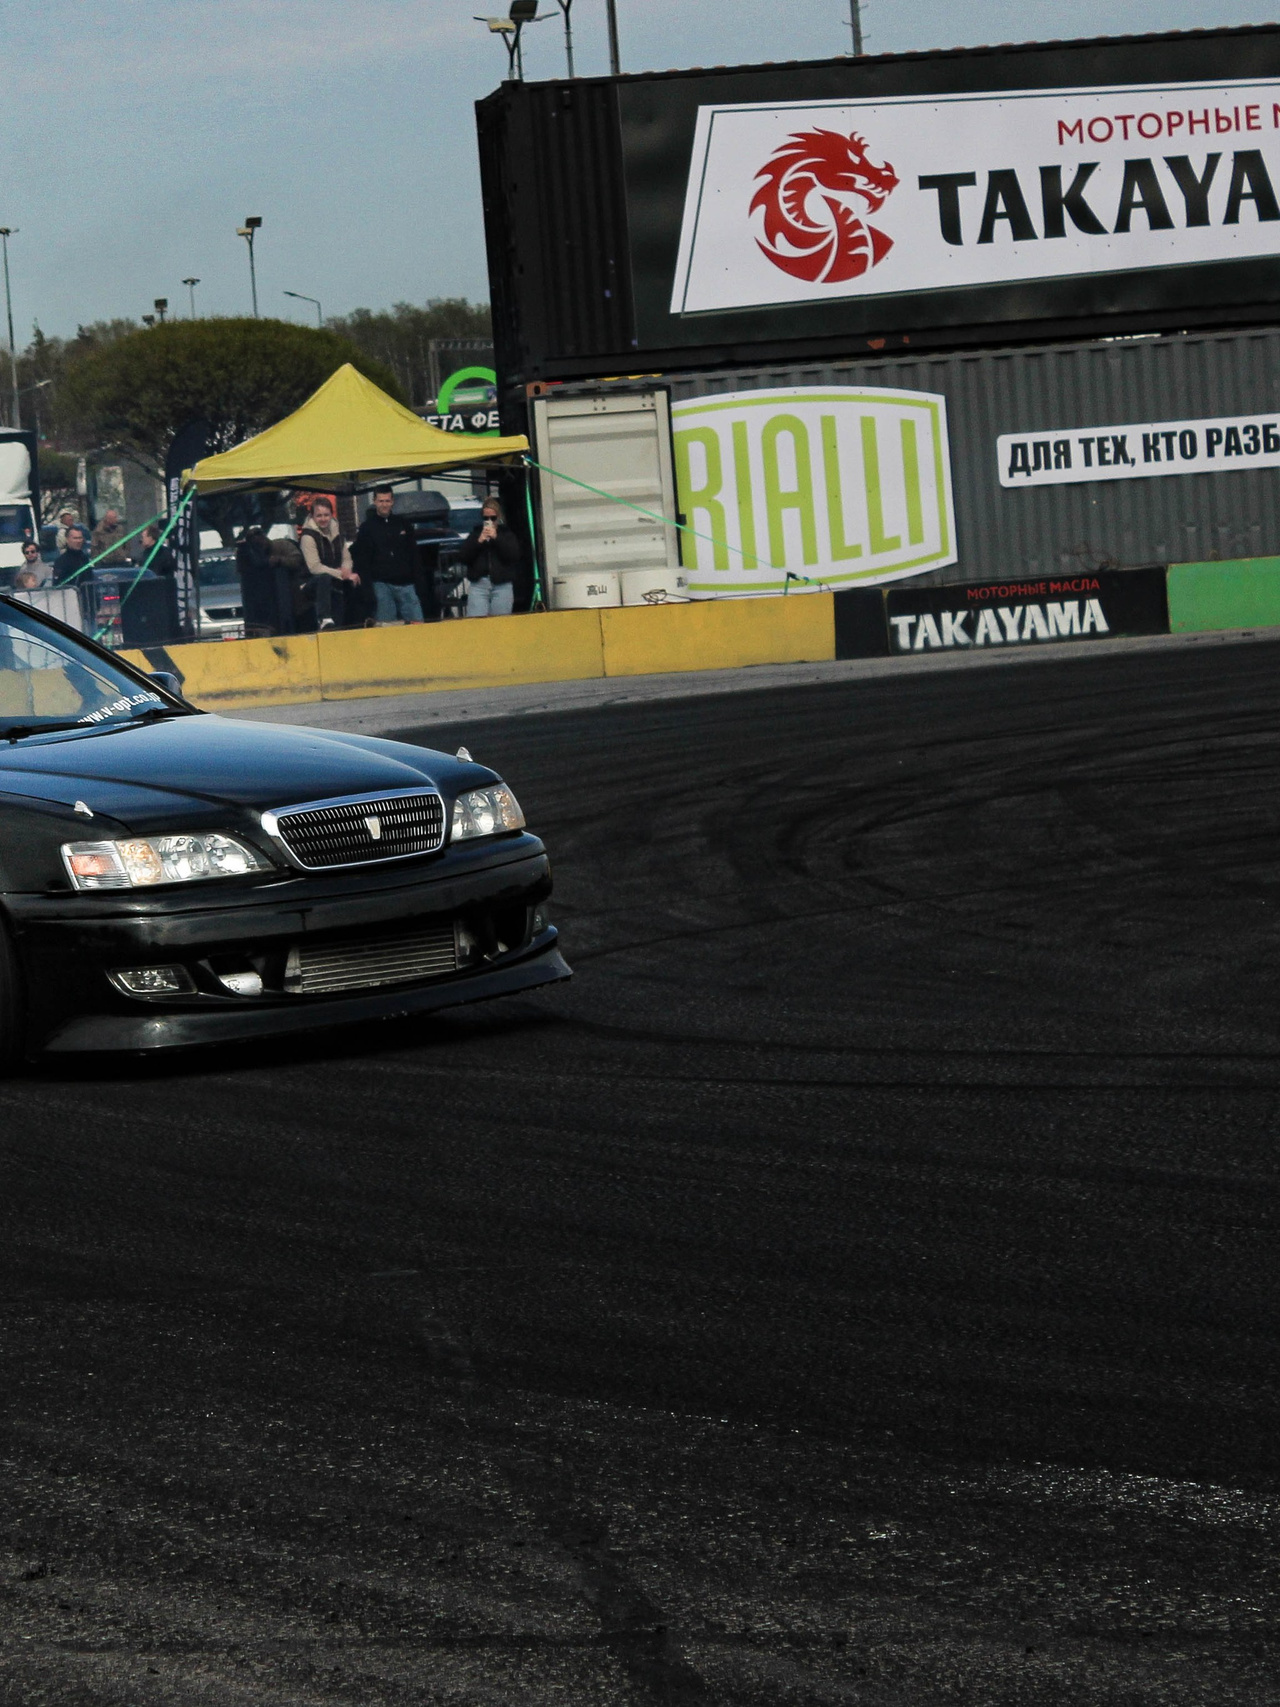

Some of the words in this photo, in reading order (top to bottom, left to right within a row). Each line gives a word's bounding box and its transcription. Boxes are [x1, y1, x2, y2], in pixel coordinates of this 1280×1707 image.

[1057, 104, 1262, 146] МОТОРНЫЕ
[1008, 439, 1071, 478] ДЛЯ
[1078, 434, 1136, 467] ТЕХ,
[1142, 429, 1198, 463] КТО
[1206, 423, 1280, 458] РАЗБ
[673, 414, 924, 571] RIALLI
[967, 582, 1047, 601] МОТОРНЫЕ
[1050, 578, 1101, 595] МАСЛА
[890, 598, 1110, 650] TAKAYAMA
